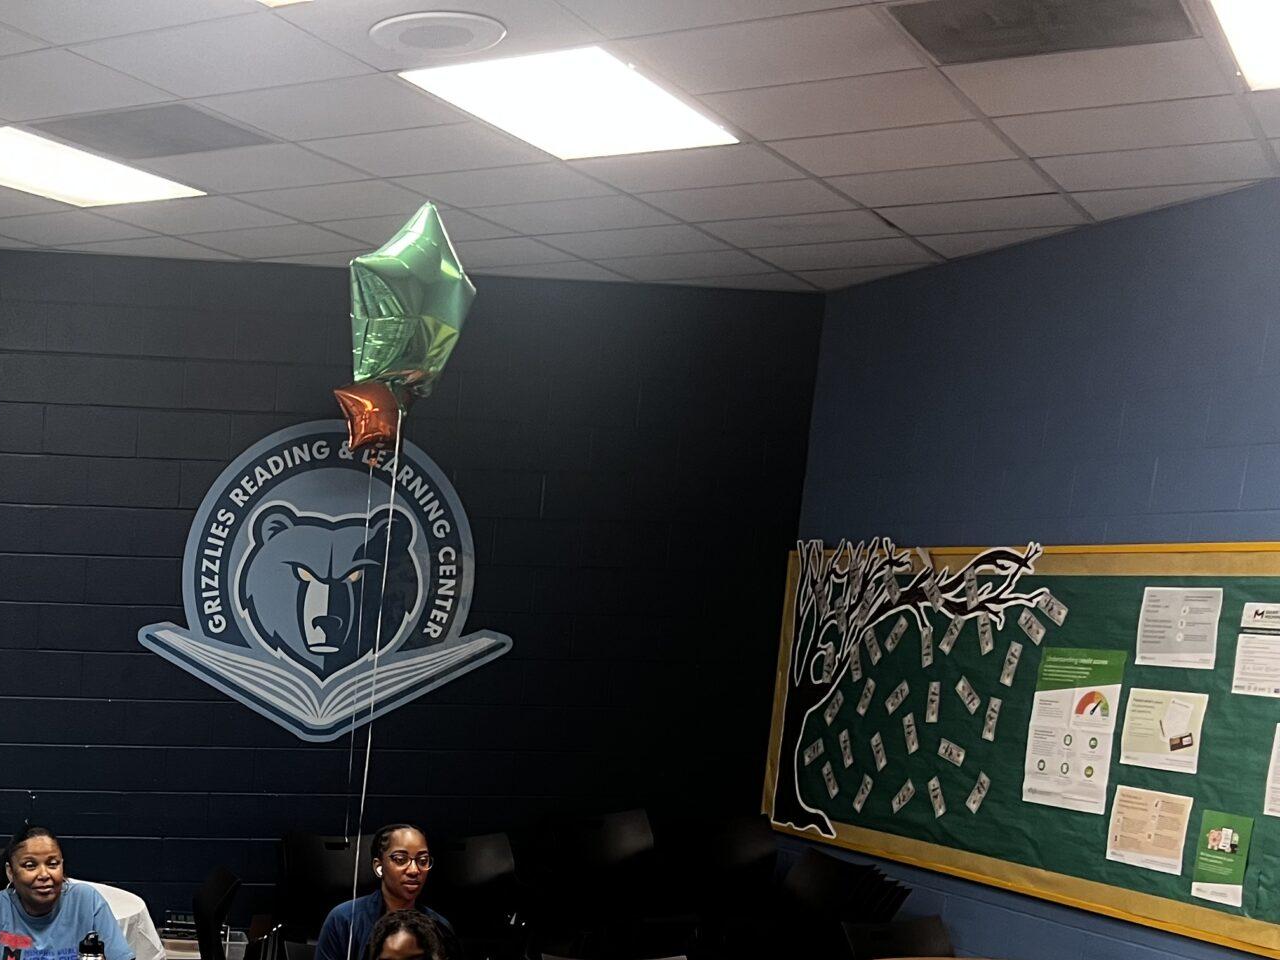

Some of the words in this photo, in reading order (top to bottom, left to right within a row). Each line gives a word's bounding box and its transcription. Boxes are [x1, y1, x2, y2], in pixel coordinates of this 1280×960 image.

[202, 508, 235, 634] GRIZZLIES
[229, 440, 330, 508] READING
[338, 440, 354, 460] &
[362, 448, 451, 539] LEARNING
[423, 546, 457, 639] CENTER
